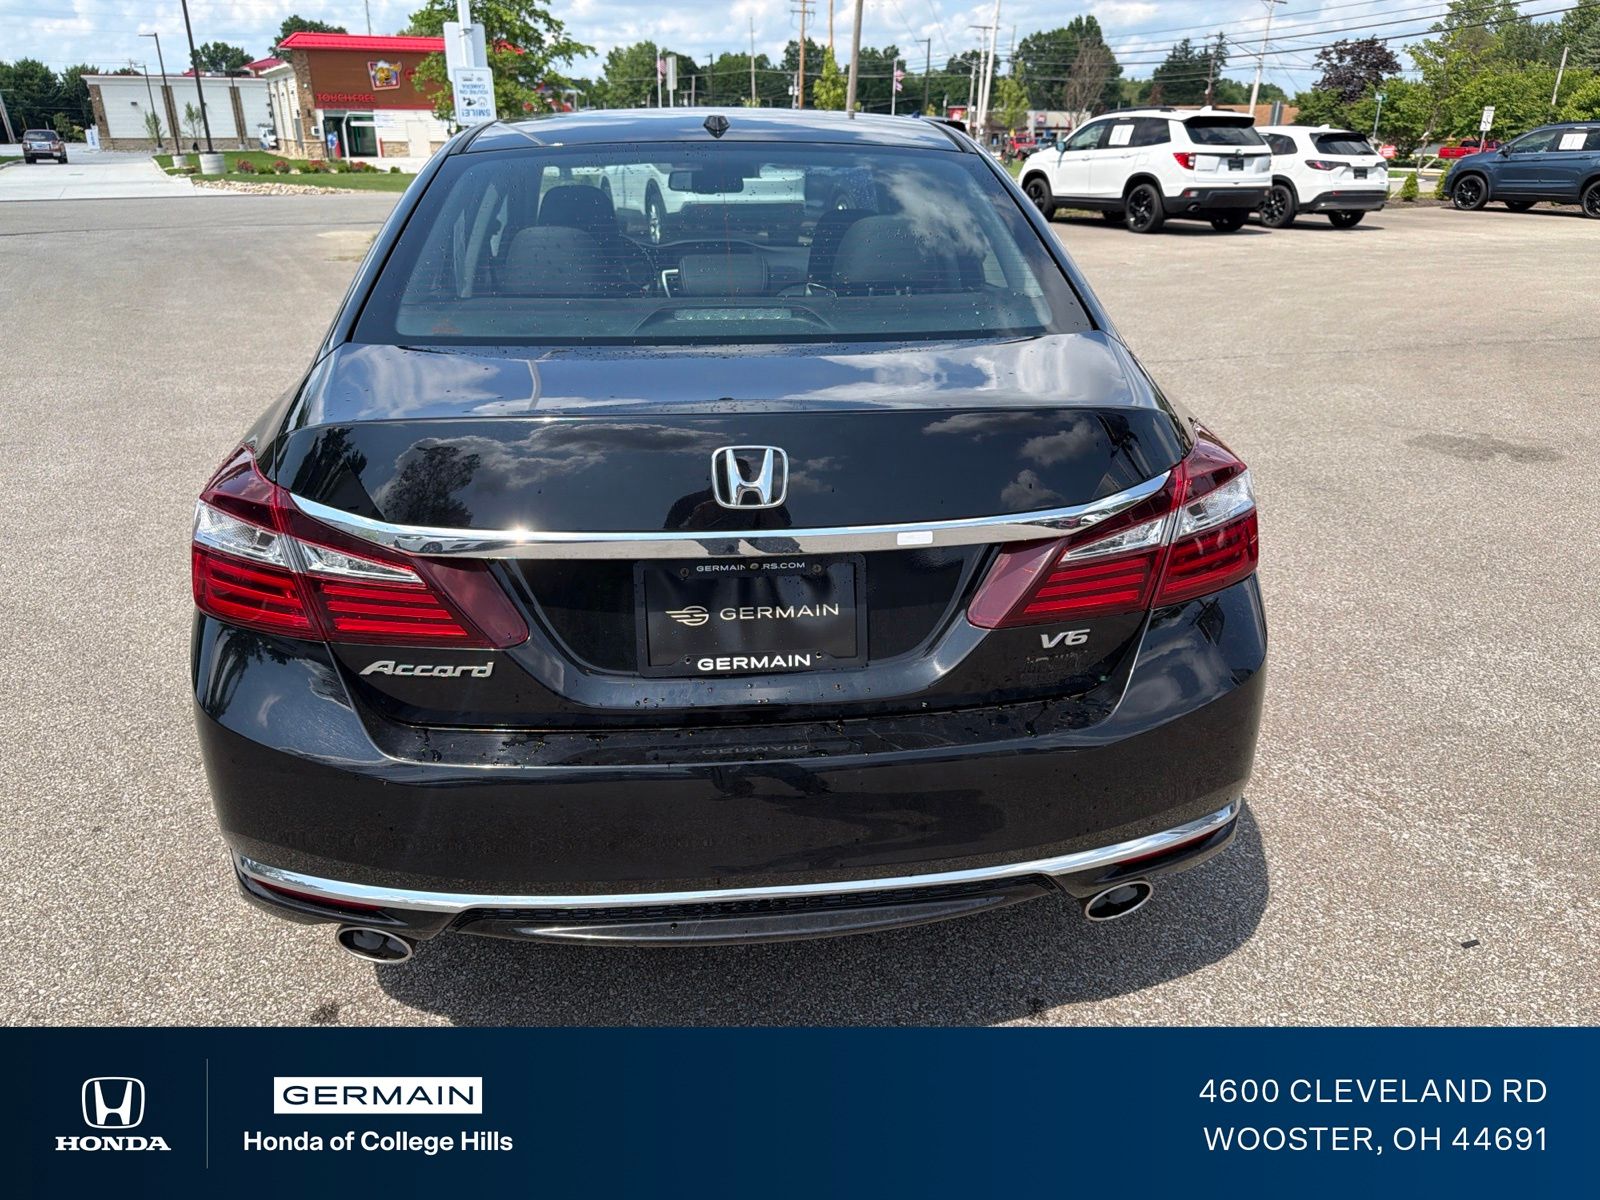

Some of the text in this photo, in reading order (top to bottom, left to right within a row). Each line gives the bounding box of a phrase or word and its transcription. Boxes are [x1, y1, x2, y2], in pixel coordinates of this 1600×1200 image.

[462, 109, 491, 117] SMILE!
[696, 562, 806, 572] GERMAINRS.COM
[720, 603, 840, 621] GERMAIN
[1040, 628, 1091, 649] V6
[359, 660, 495, 678] Accord
[697, 654, 811, 671] GERMAIN
